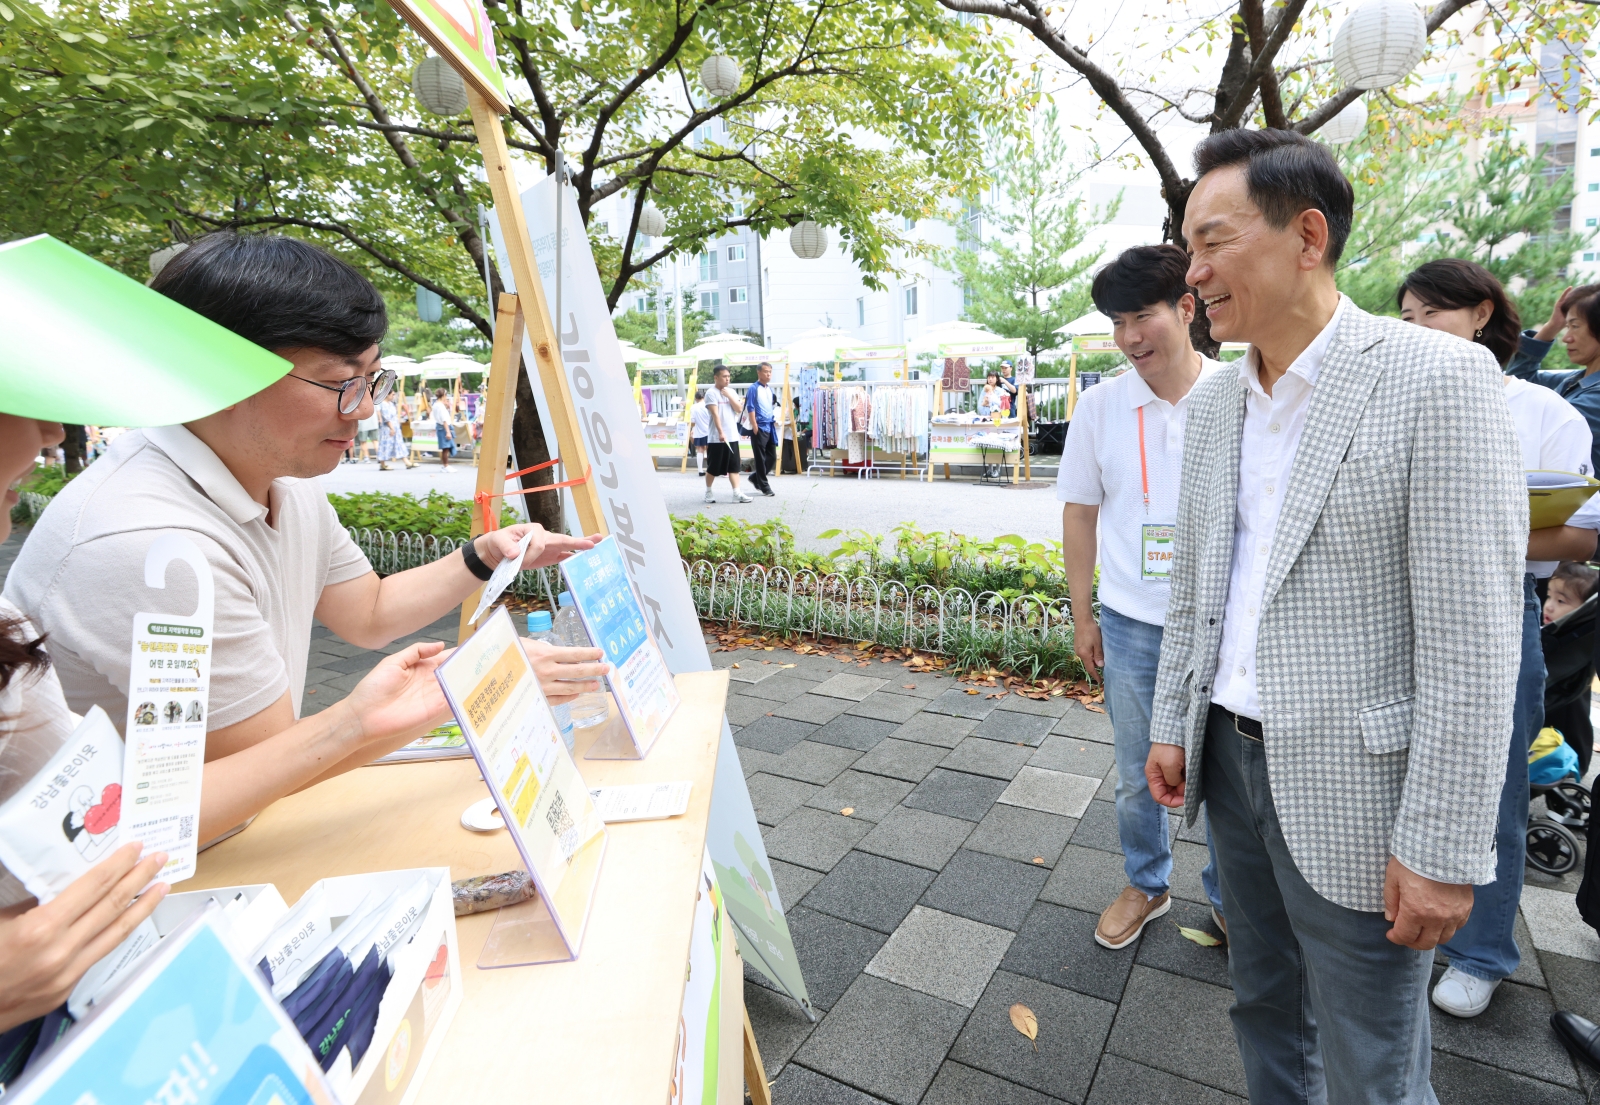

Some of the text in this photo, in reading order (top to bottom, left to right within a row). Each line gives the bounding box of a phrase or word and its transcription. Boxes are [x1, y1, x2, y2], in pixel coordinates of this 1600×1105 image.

[1147, 551, 1173, 561] STAF
[149, 659, 198, 669] 어떤 곳일까요?
[474, 710, 486, 728] 소식을
[489, 690, 501, 707] 빠르게
[30, 744, 98, 810] 강남좋은이웃
